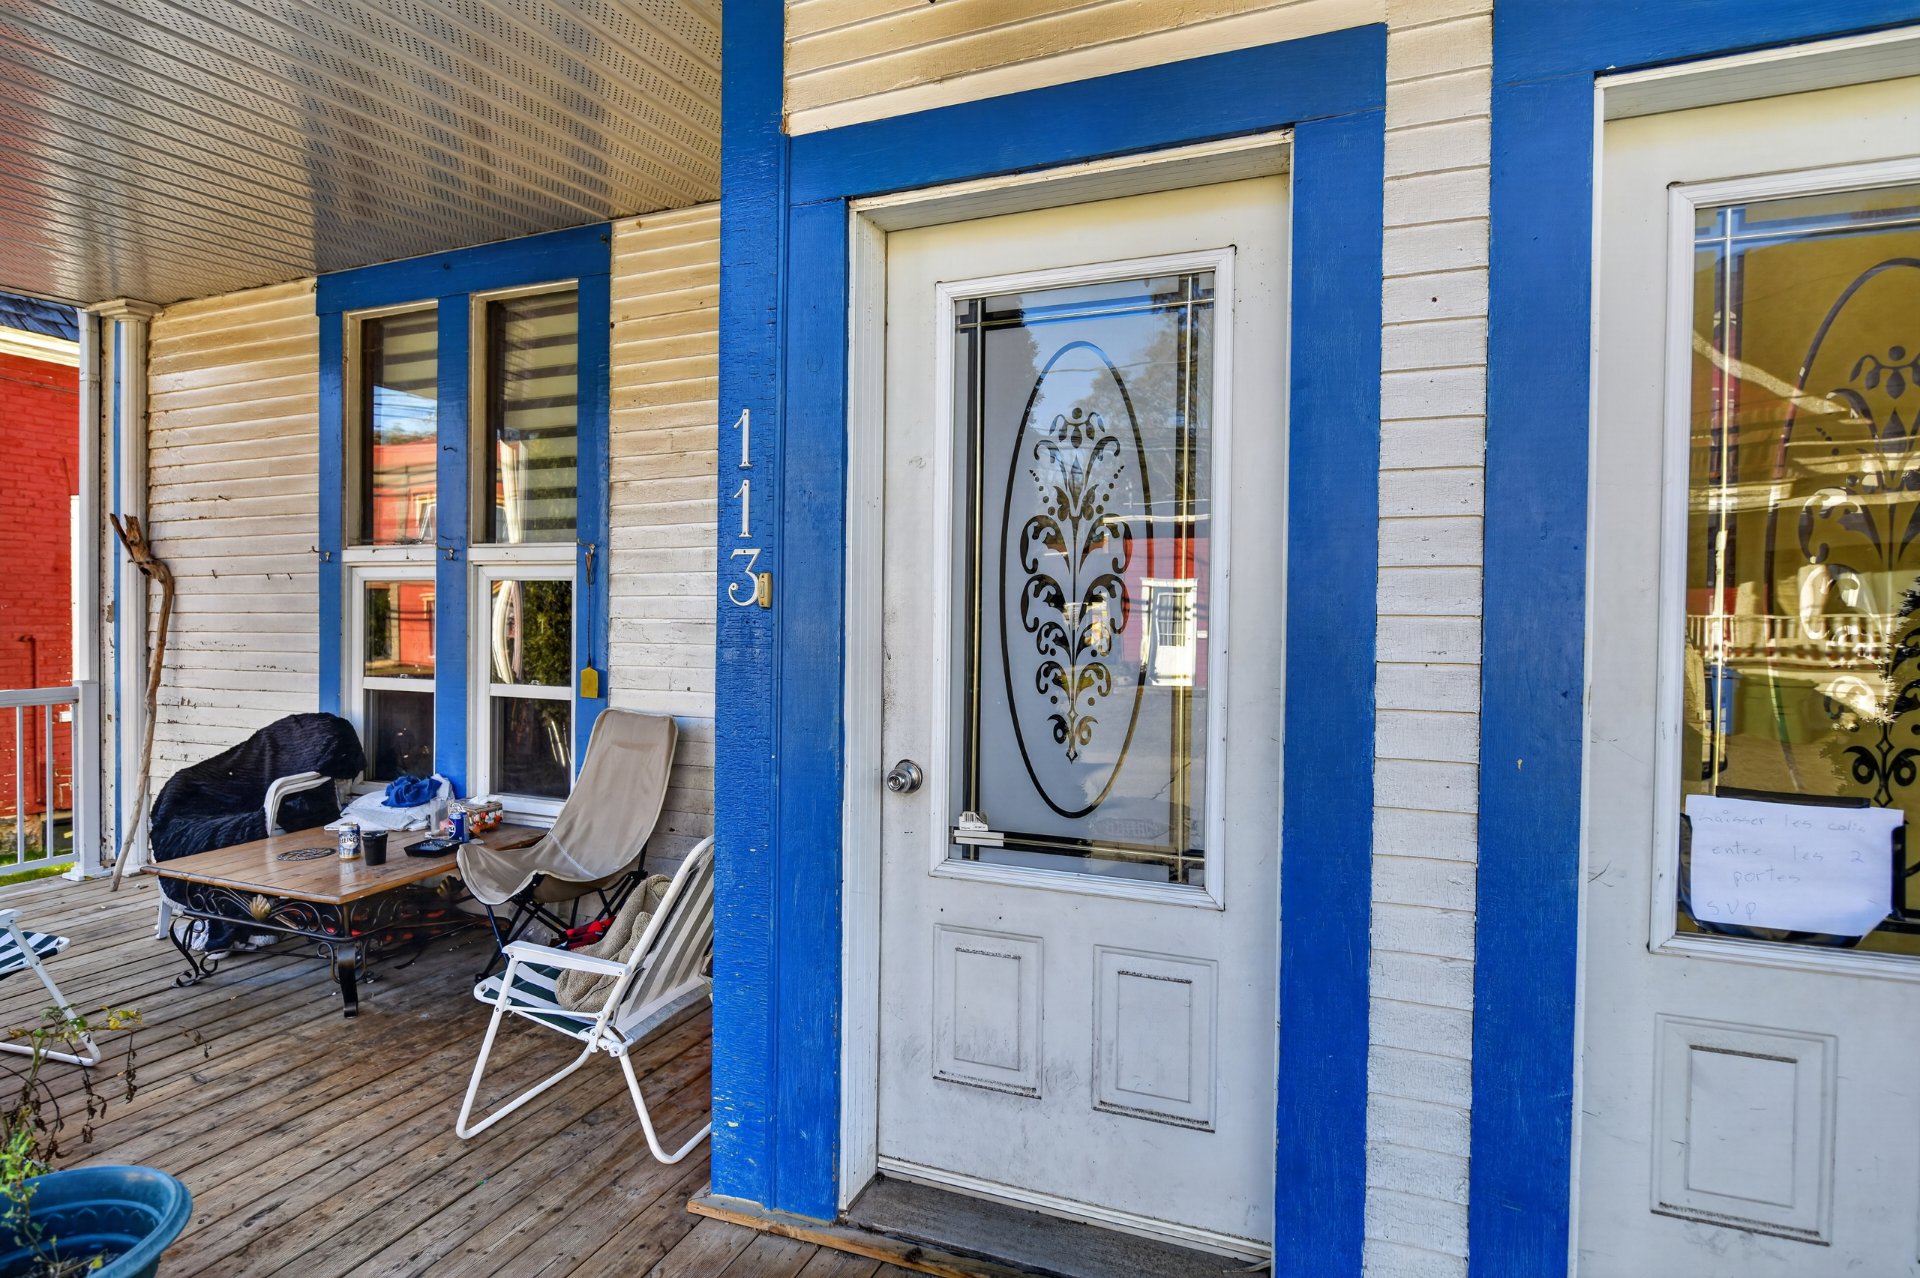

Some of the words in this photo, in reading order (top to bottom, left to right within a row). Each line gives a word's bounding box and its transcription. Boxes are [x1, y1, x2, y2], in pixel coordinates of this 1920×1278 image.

[728, 408, 761, 606] 113
[1784, 813, 1813, 829] les
[1711, 840, 1762, 857] entre
[1792, 845, 1824, 862] les
[1850, 850, 1864, 864] 2
[1733, 865, 1801, 888] portes
